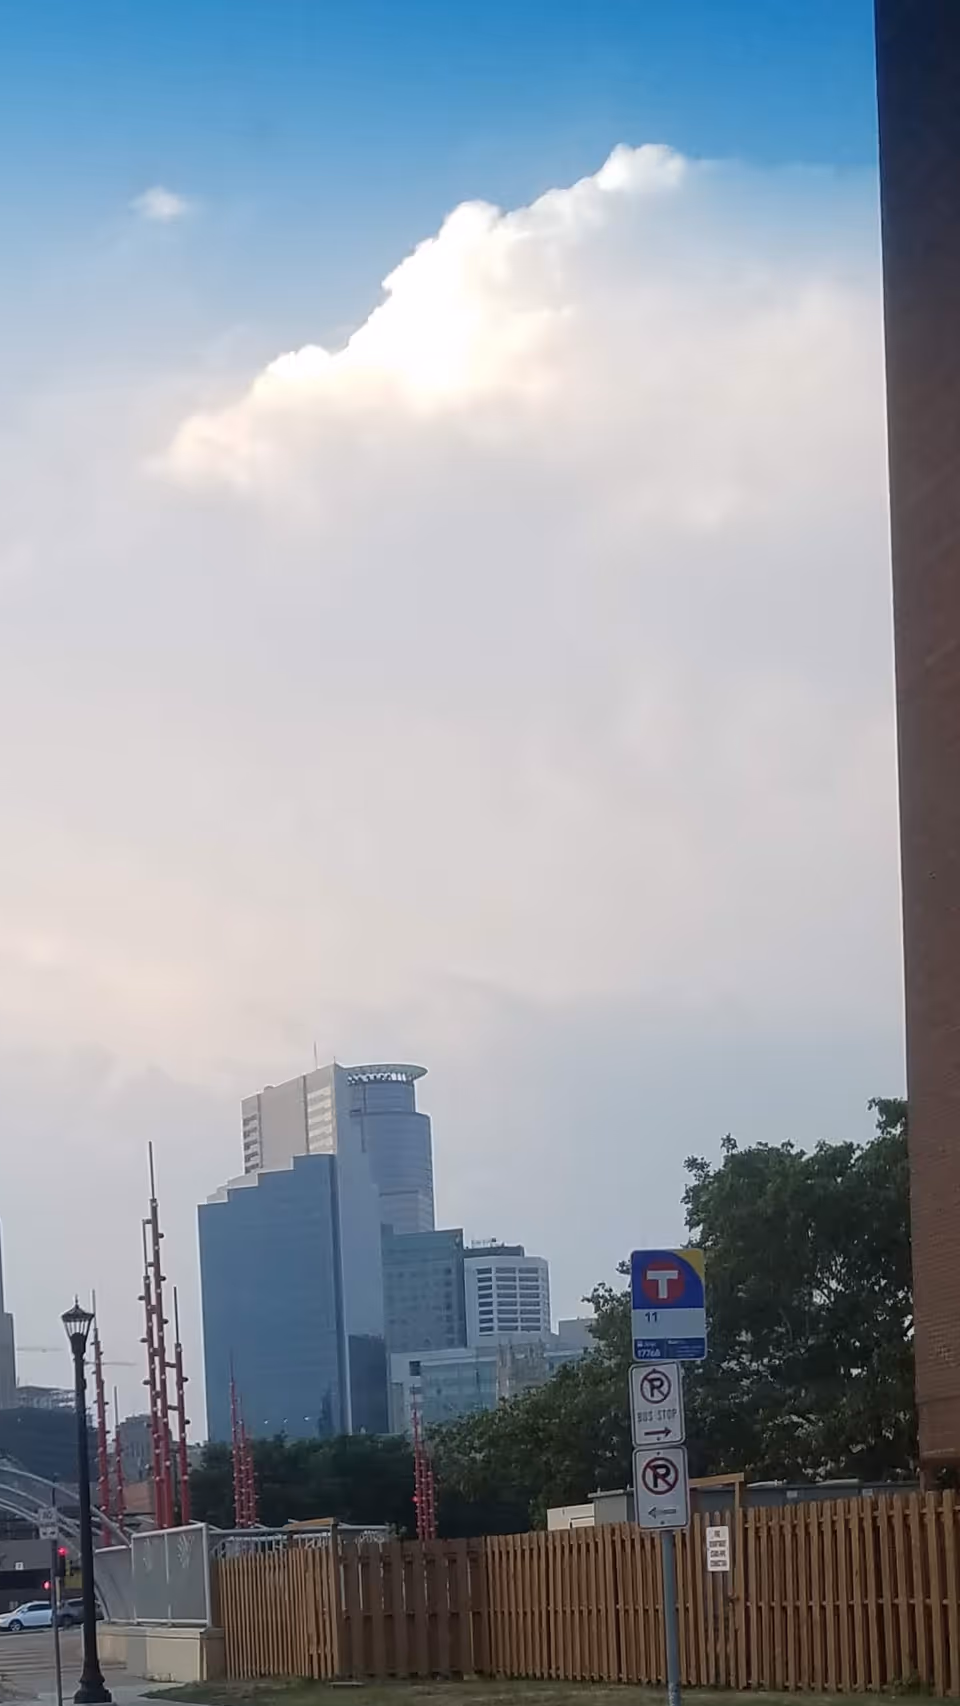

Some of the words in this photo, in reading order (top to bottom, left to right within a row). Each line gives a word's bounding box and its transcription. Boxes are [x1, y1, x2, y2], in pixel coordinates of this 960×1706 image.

[646, 1270, 679, 1299] T
[645, 1311, 658, 1322] 11
[637, 1411, 653, 1422] BUS
[658, 1408, 677, 1420] STOP
